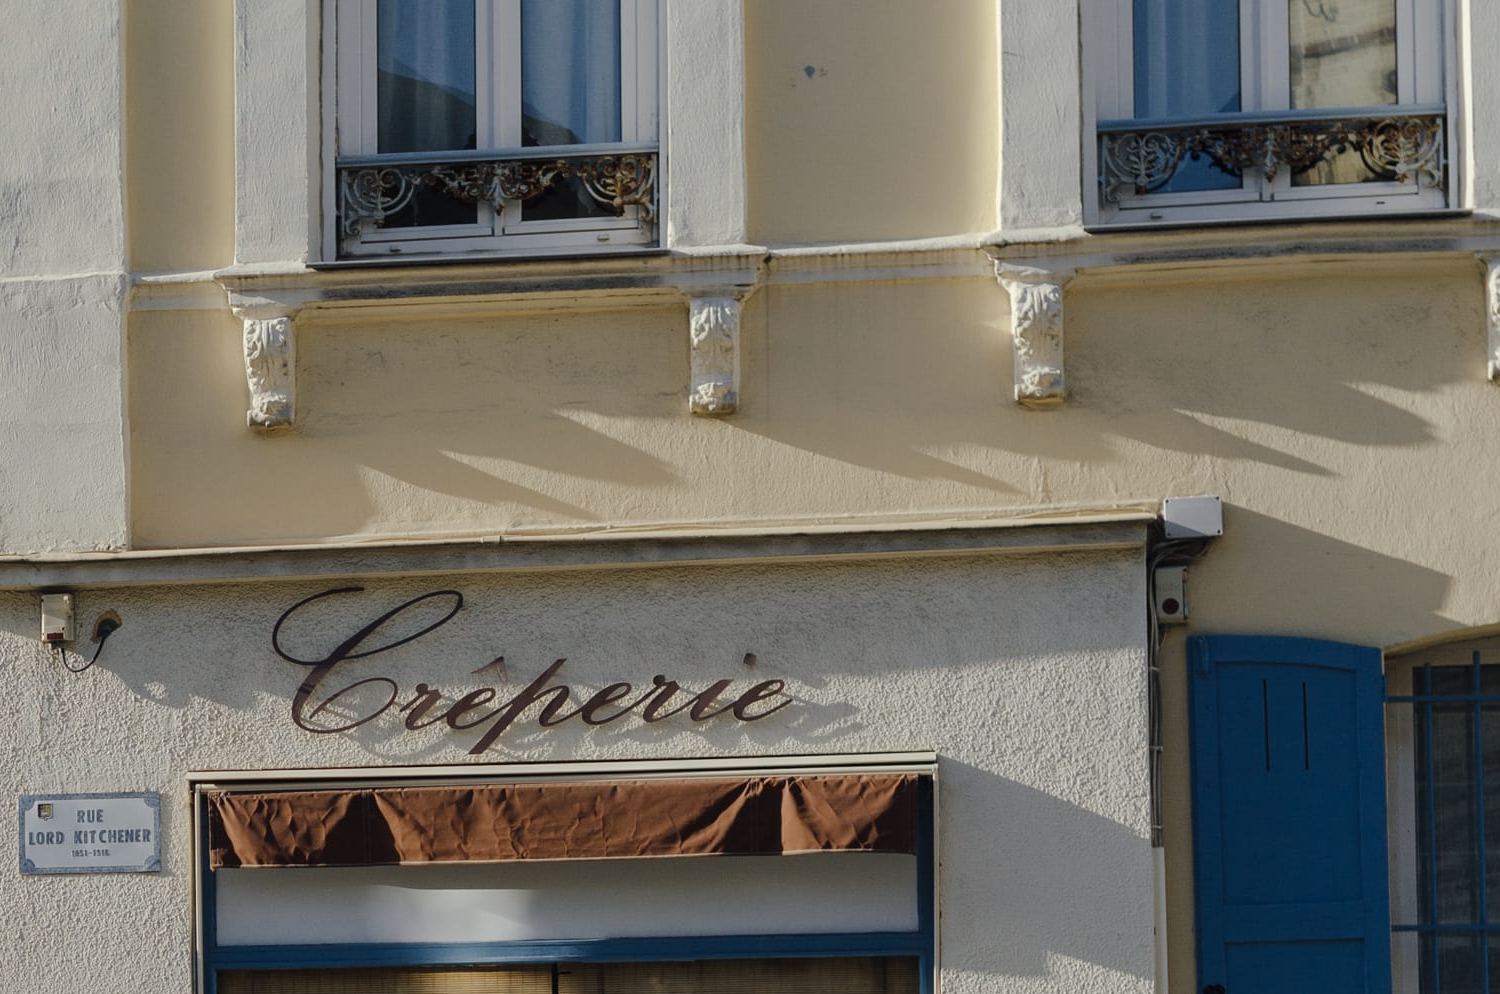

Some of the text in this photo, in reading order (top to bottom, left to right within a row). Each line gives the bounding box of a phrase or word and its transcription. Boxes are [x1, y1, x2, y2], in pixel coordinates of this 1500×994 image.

[272, 587, 793, 755] Crêperie
[77, 809, 104, 823] RUE
[28, 829, 151, 845] LORD KITCHENER
